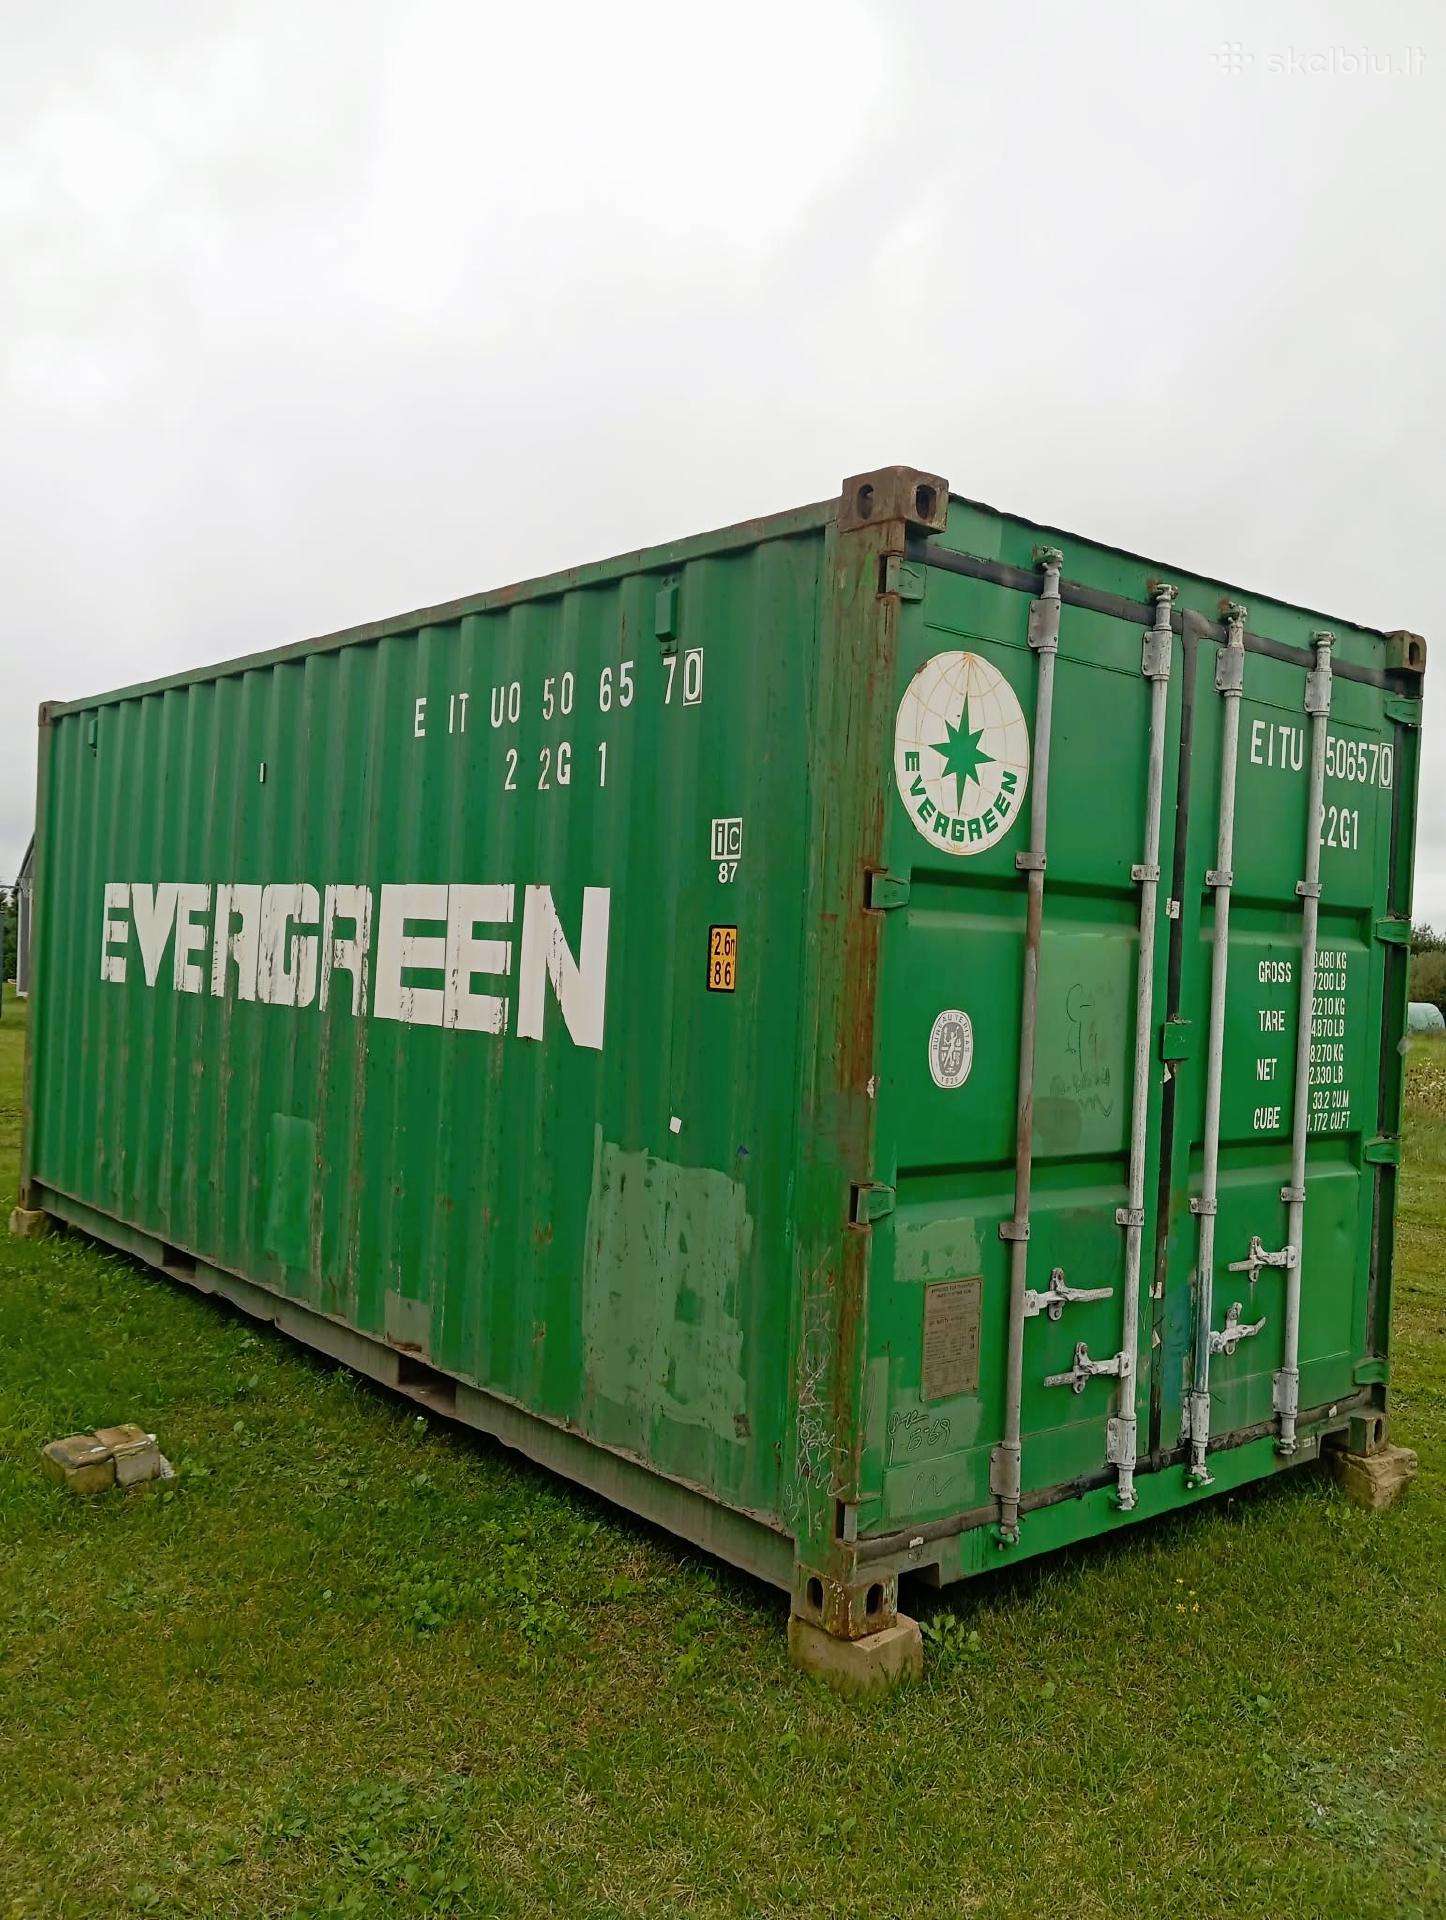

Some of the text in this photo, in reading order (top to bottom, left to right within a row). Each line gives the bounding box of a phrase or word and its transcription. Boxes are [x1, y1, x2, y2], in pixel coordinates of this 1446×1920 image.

[1250, 719, 1304, 772] EITU
[903, 751, 1019, 843] EVERGREEN
[718, 862, 738, 884] 87
[100, 882, 611, 1051] EVERGREEN
[1336, 951, 1347, 970] KG
[1258, 961, 1292, 983] GROSS
[1335, 972, 1346, 991] LB
[1334, 997, 1345, 1016] KG
[1258, 1010, 1286, 1032] TARE
[1334, 1019, 1345, 1037] LB
[1333, 1043, 1344, 1062] KG
[1256, 1058, 1278, 1081] NET
[1333, 1065, 1344, 1084] LB
[1253, 1106, 1281, 1130] CUBE
